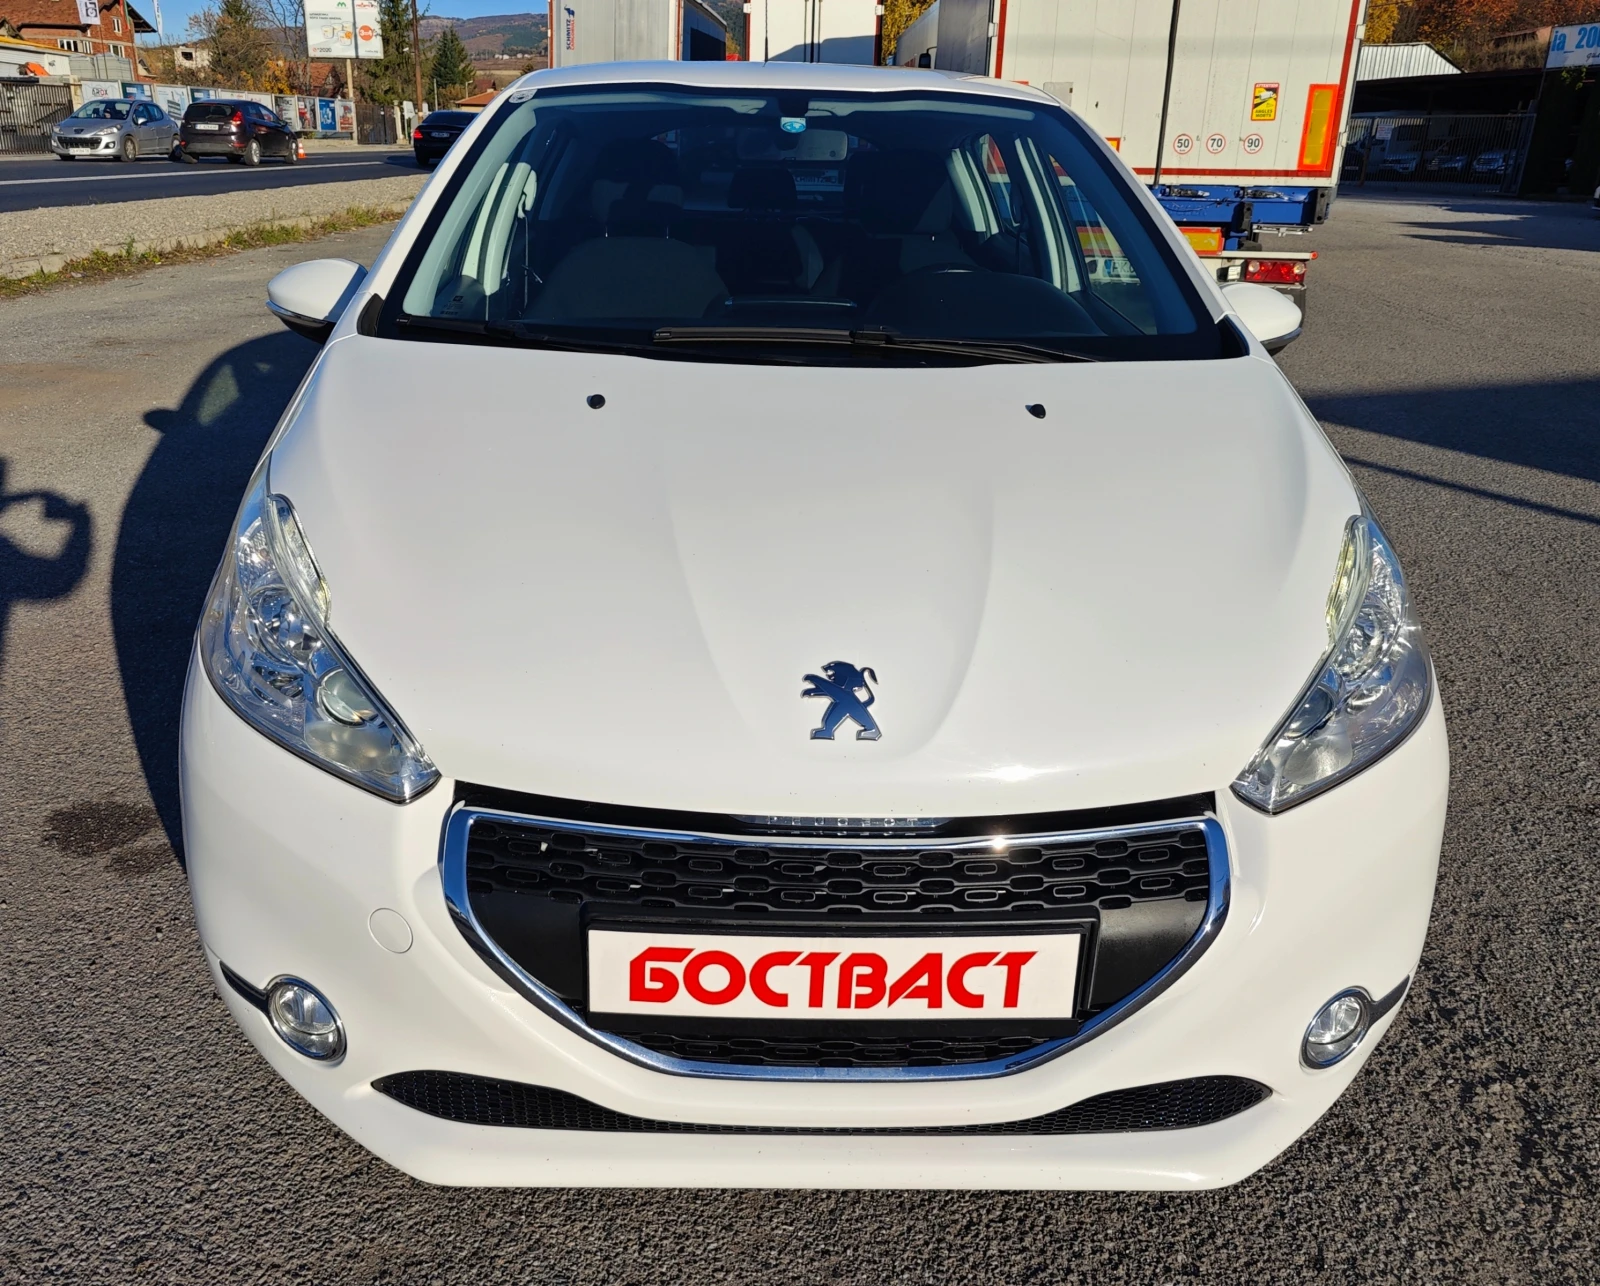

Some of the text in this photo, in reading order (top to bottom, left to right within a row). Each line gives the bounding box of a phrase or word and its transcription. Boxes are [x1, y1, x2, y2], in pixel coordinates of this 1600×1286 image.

[1177, 138, 1190, 148] 50
[1210, 138, 1223, 148] 70
[1247, 138, 1260, 148] 90
[767, 816, 918, 827] PEUGEOT
[629, 946, 1038, 1009] БОСТВАСТ
